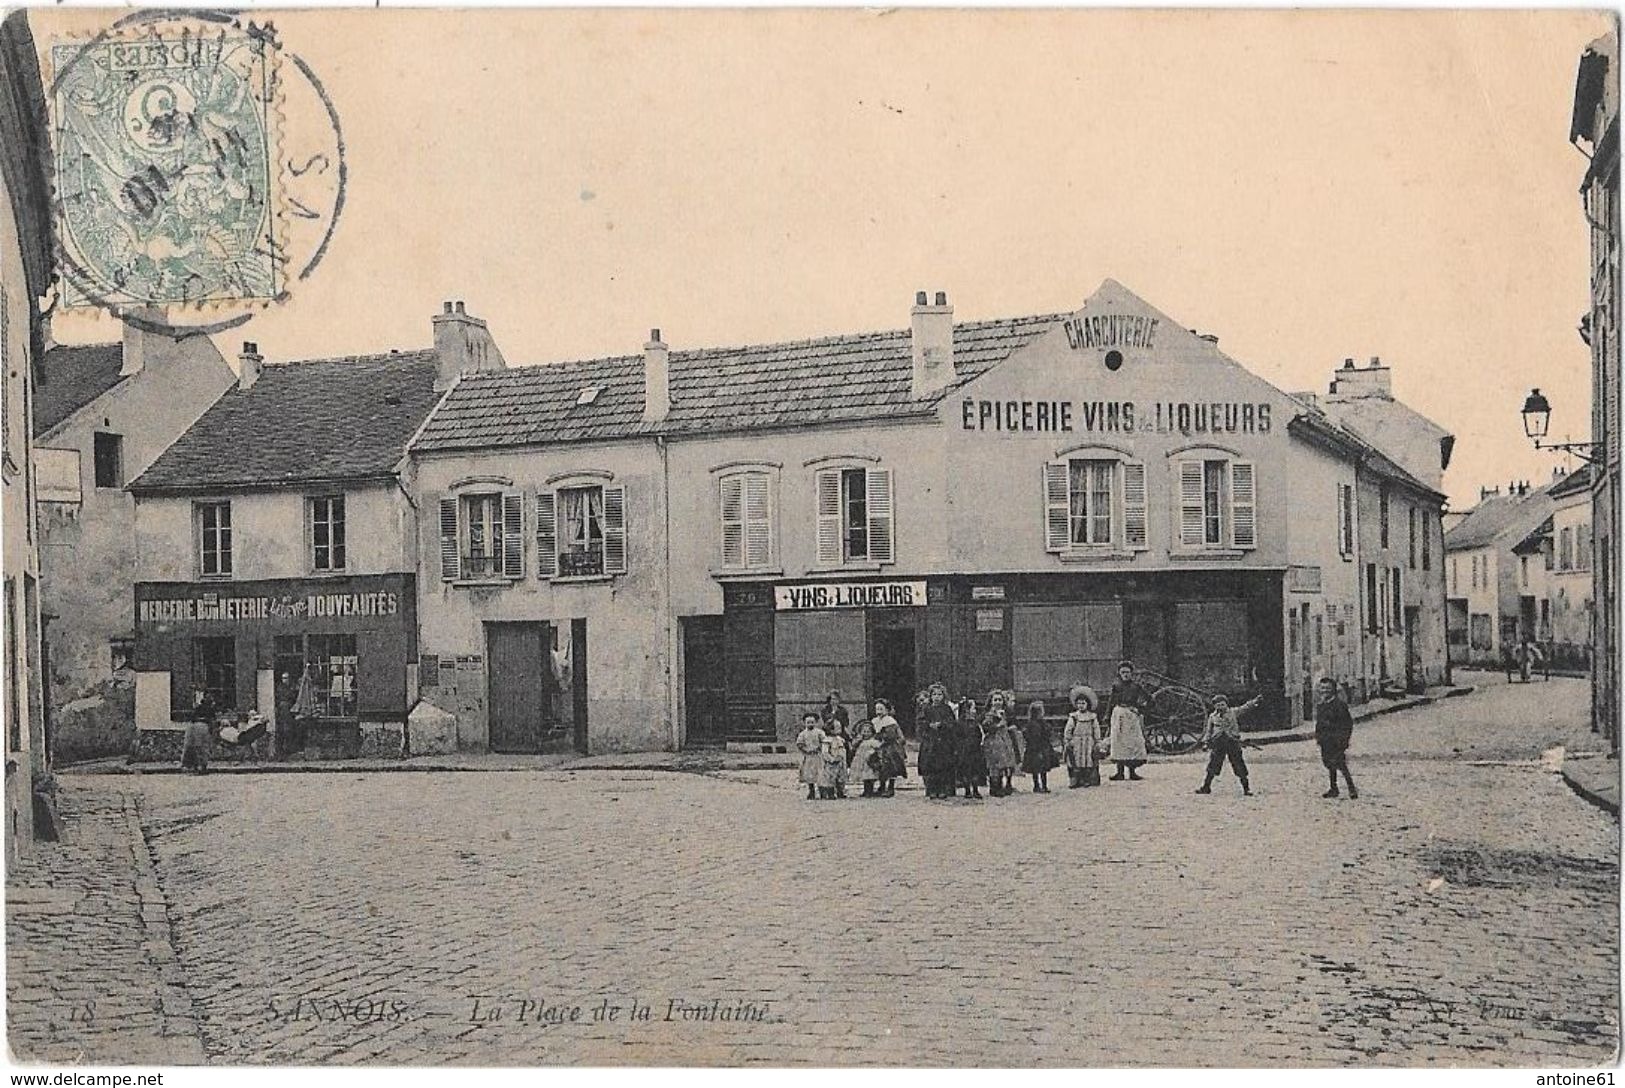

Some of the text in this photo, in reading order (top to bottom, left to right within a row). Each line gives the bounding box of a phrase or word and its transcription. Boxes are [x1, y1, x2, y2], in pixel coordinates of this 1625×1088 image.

[1063, 314, 1160, 350] CHARCUTERIE
[962, 396, 1073, 432] ÉPICERIE
[1083, 401, 1135, 433] VINS
[1155, 402, 1271, 437] LIQUEURS
[140, 599, 196, 621] MERCERIE
[308, 590, 398, 617] NOUVEAUTÉS
[789, 587, 827, 608] VINS
[835, 584, 913, 605] LIQUEURS
